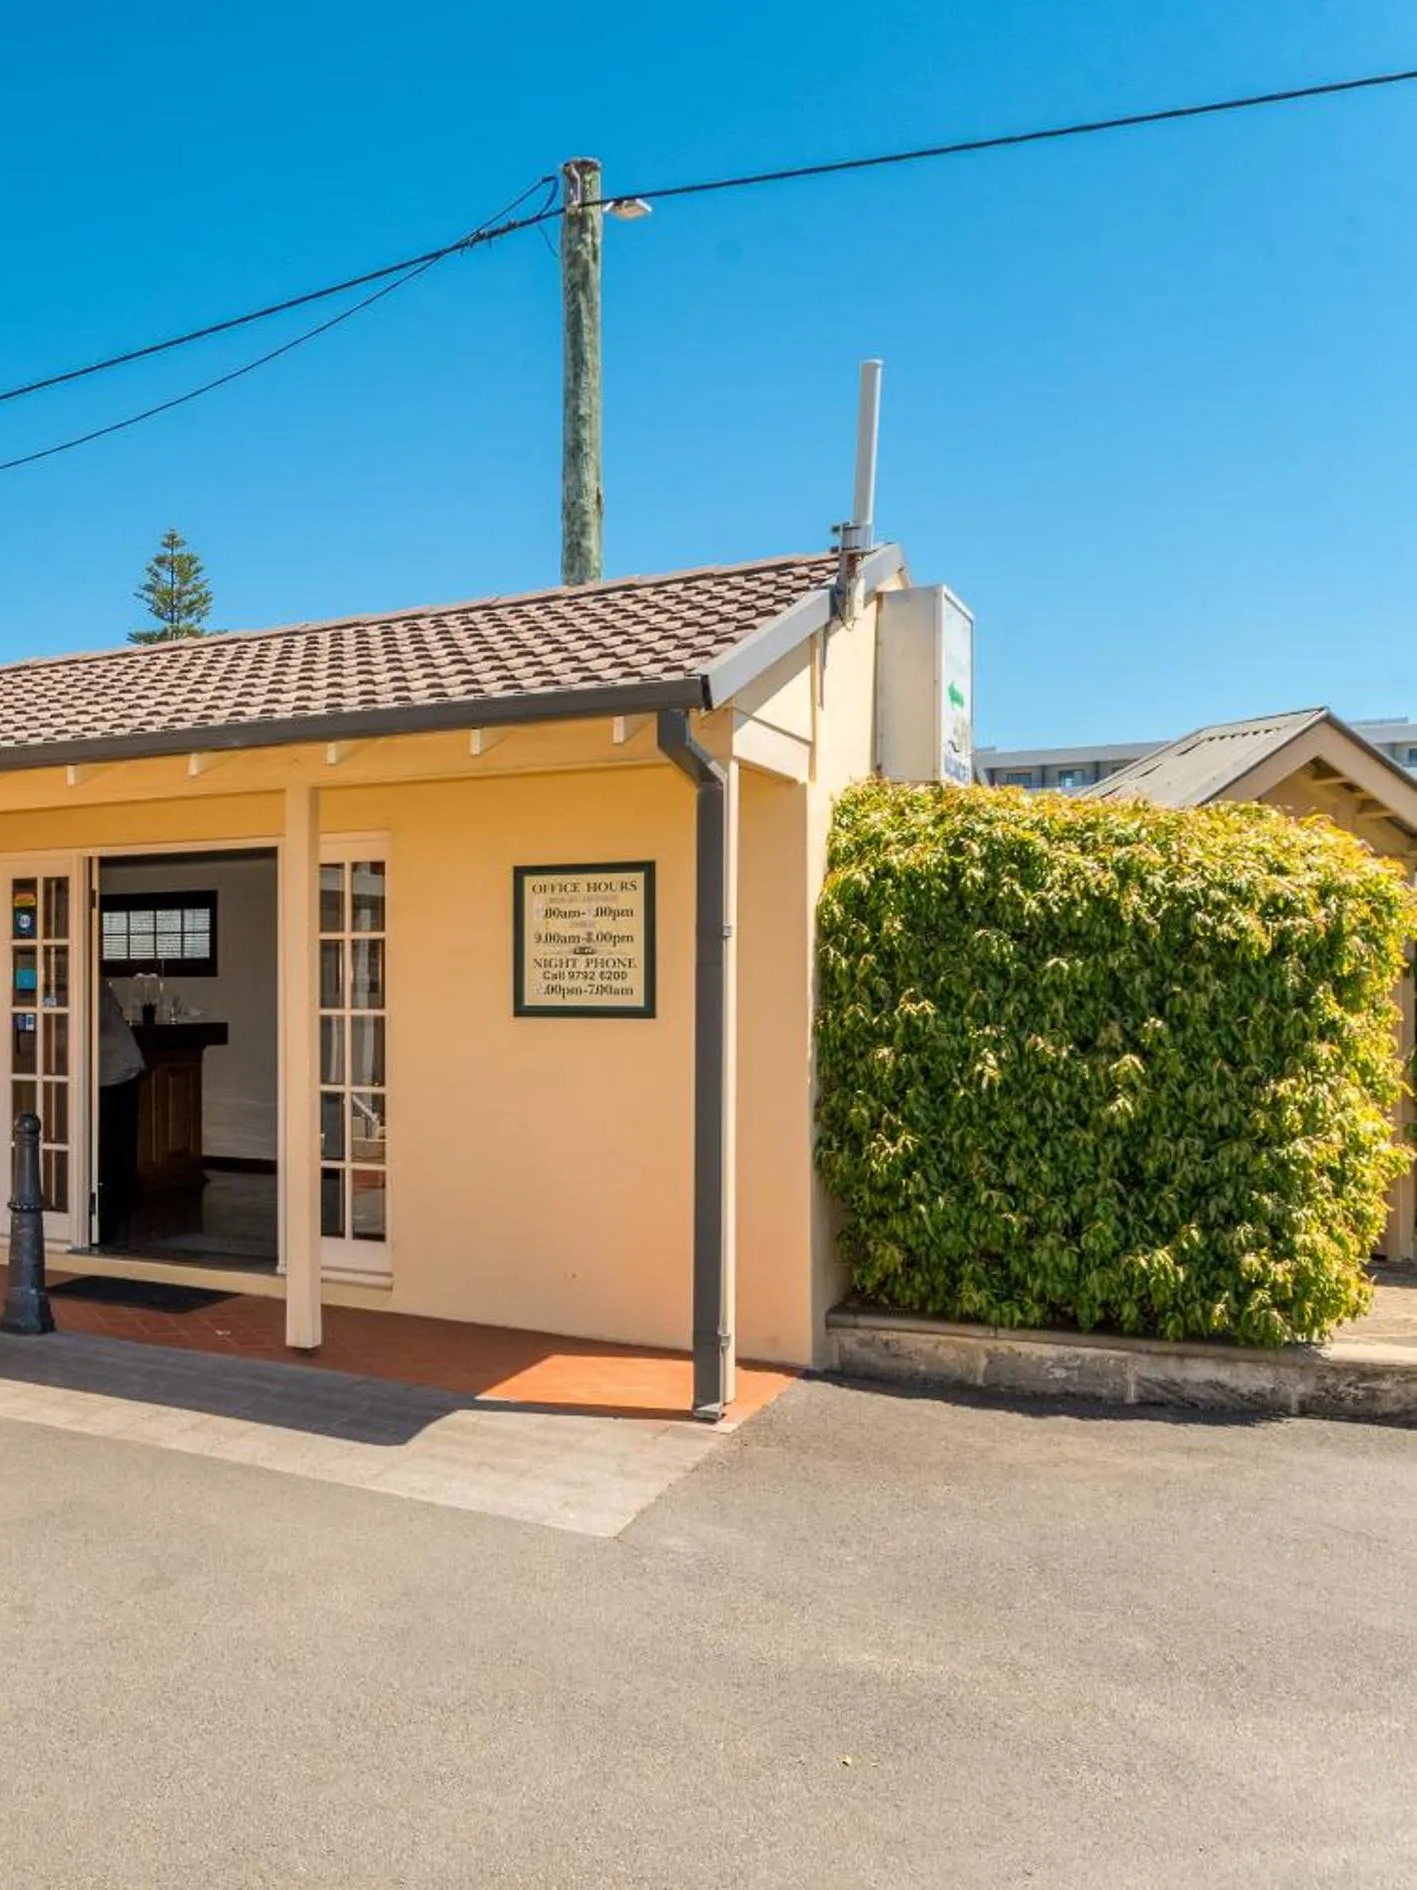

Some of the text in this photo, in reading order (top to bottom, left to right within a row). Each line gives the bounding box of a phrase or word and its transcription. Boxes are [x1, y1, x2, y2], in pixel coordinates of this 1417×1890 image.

[532, 880, 638, 895] OFFICE HOURS
[533, 957, 637, 969] NIGHT PHONE
[542, 971, 565, 981] Call
[568, 971, 595, 981] 9792
